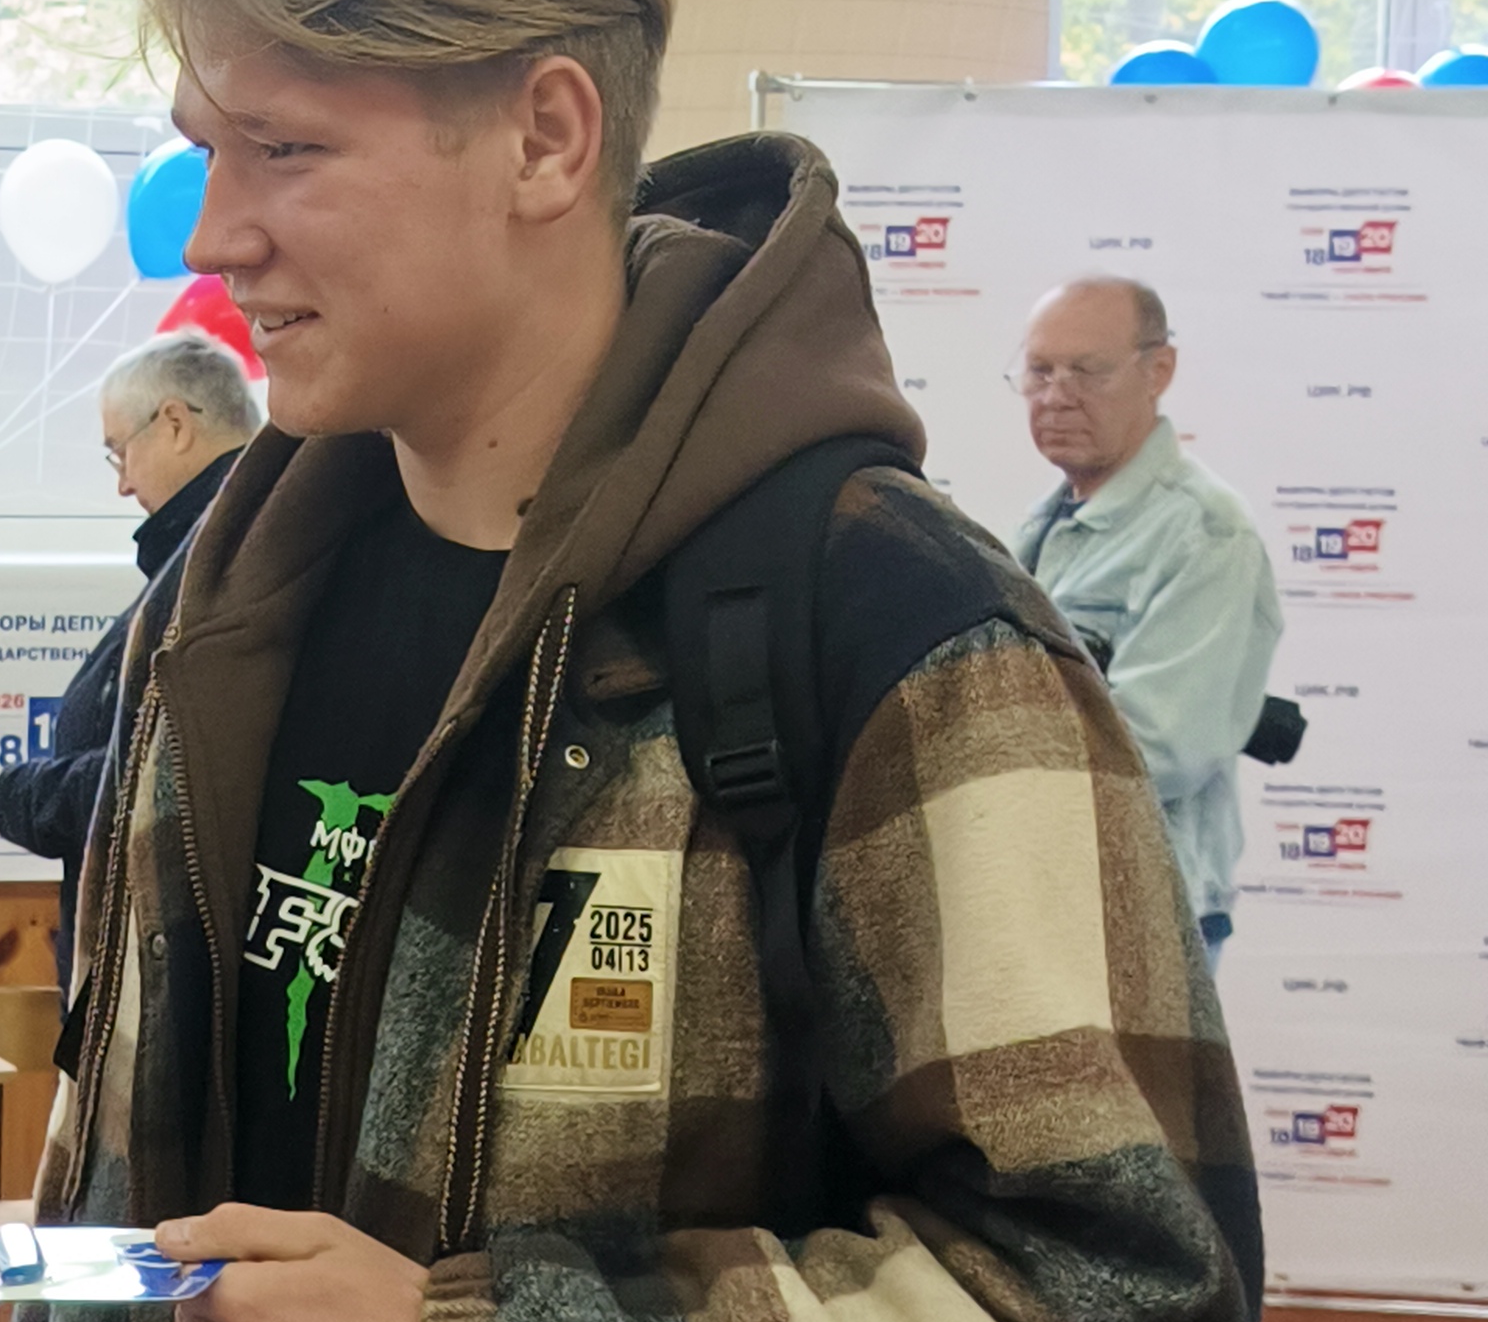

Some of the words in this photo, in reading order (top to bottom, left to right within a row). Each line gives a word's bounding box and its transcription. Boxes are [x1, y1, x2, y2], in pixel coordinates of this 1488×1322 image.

[887, 232, 912, 252] 19
[914, 223, 945, 244] 20
[1303, 248, 1326, 265] 18
[1360, 227, 1391, 248] 20
[1291, 544, 1314, 562] 18
[1318, 533, 1344, 555] 19
[1346, 525, 1377, 547] 20
[1279, 842, 1301, 860] 18
[1334, 823, 1366, 845] 20
[589, 909, 653, 943] 2025
